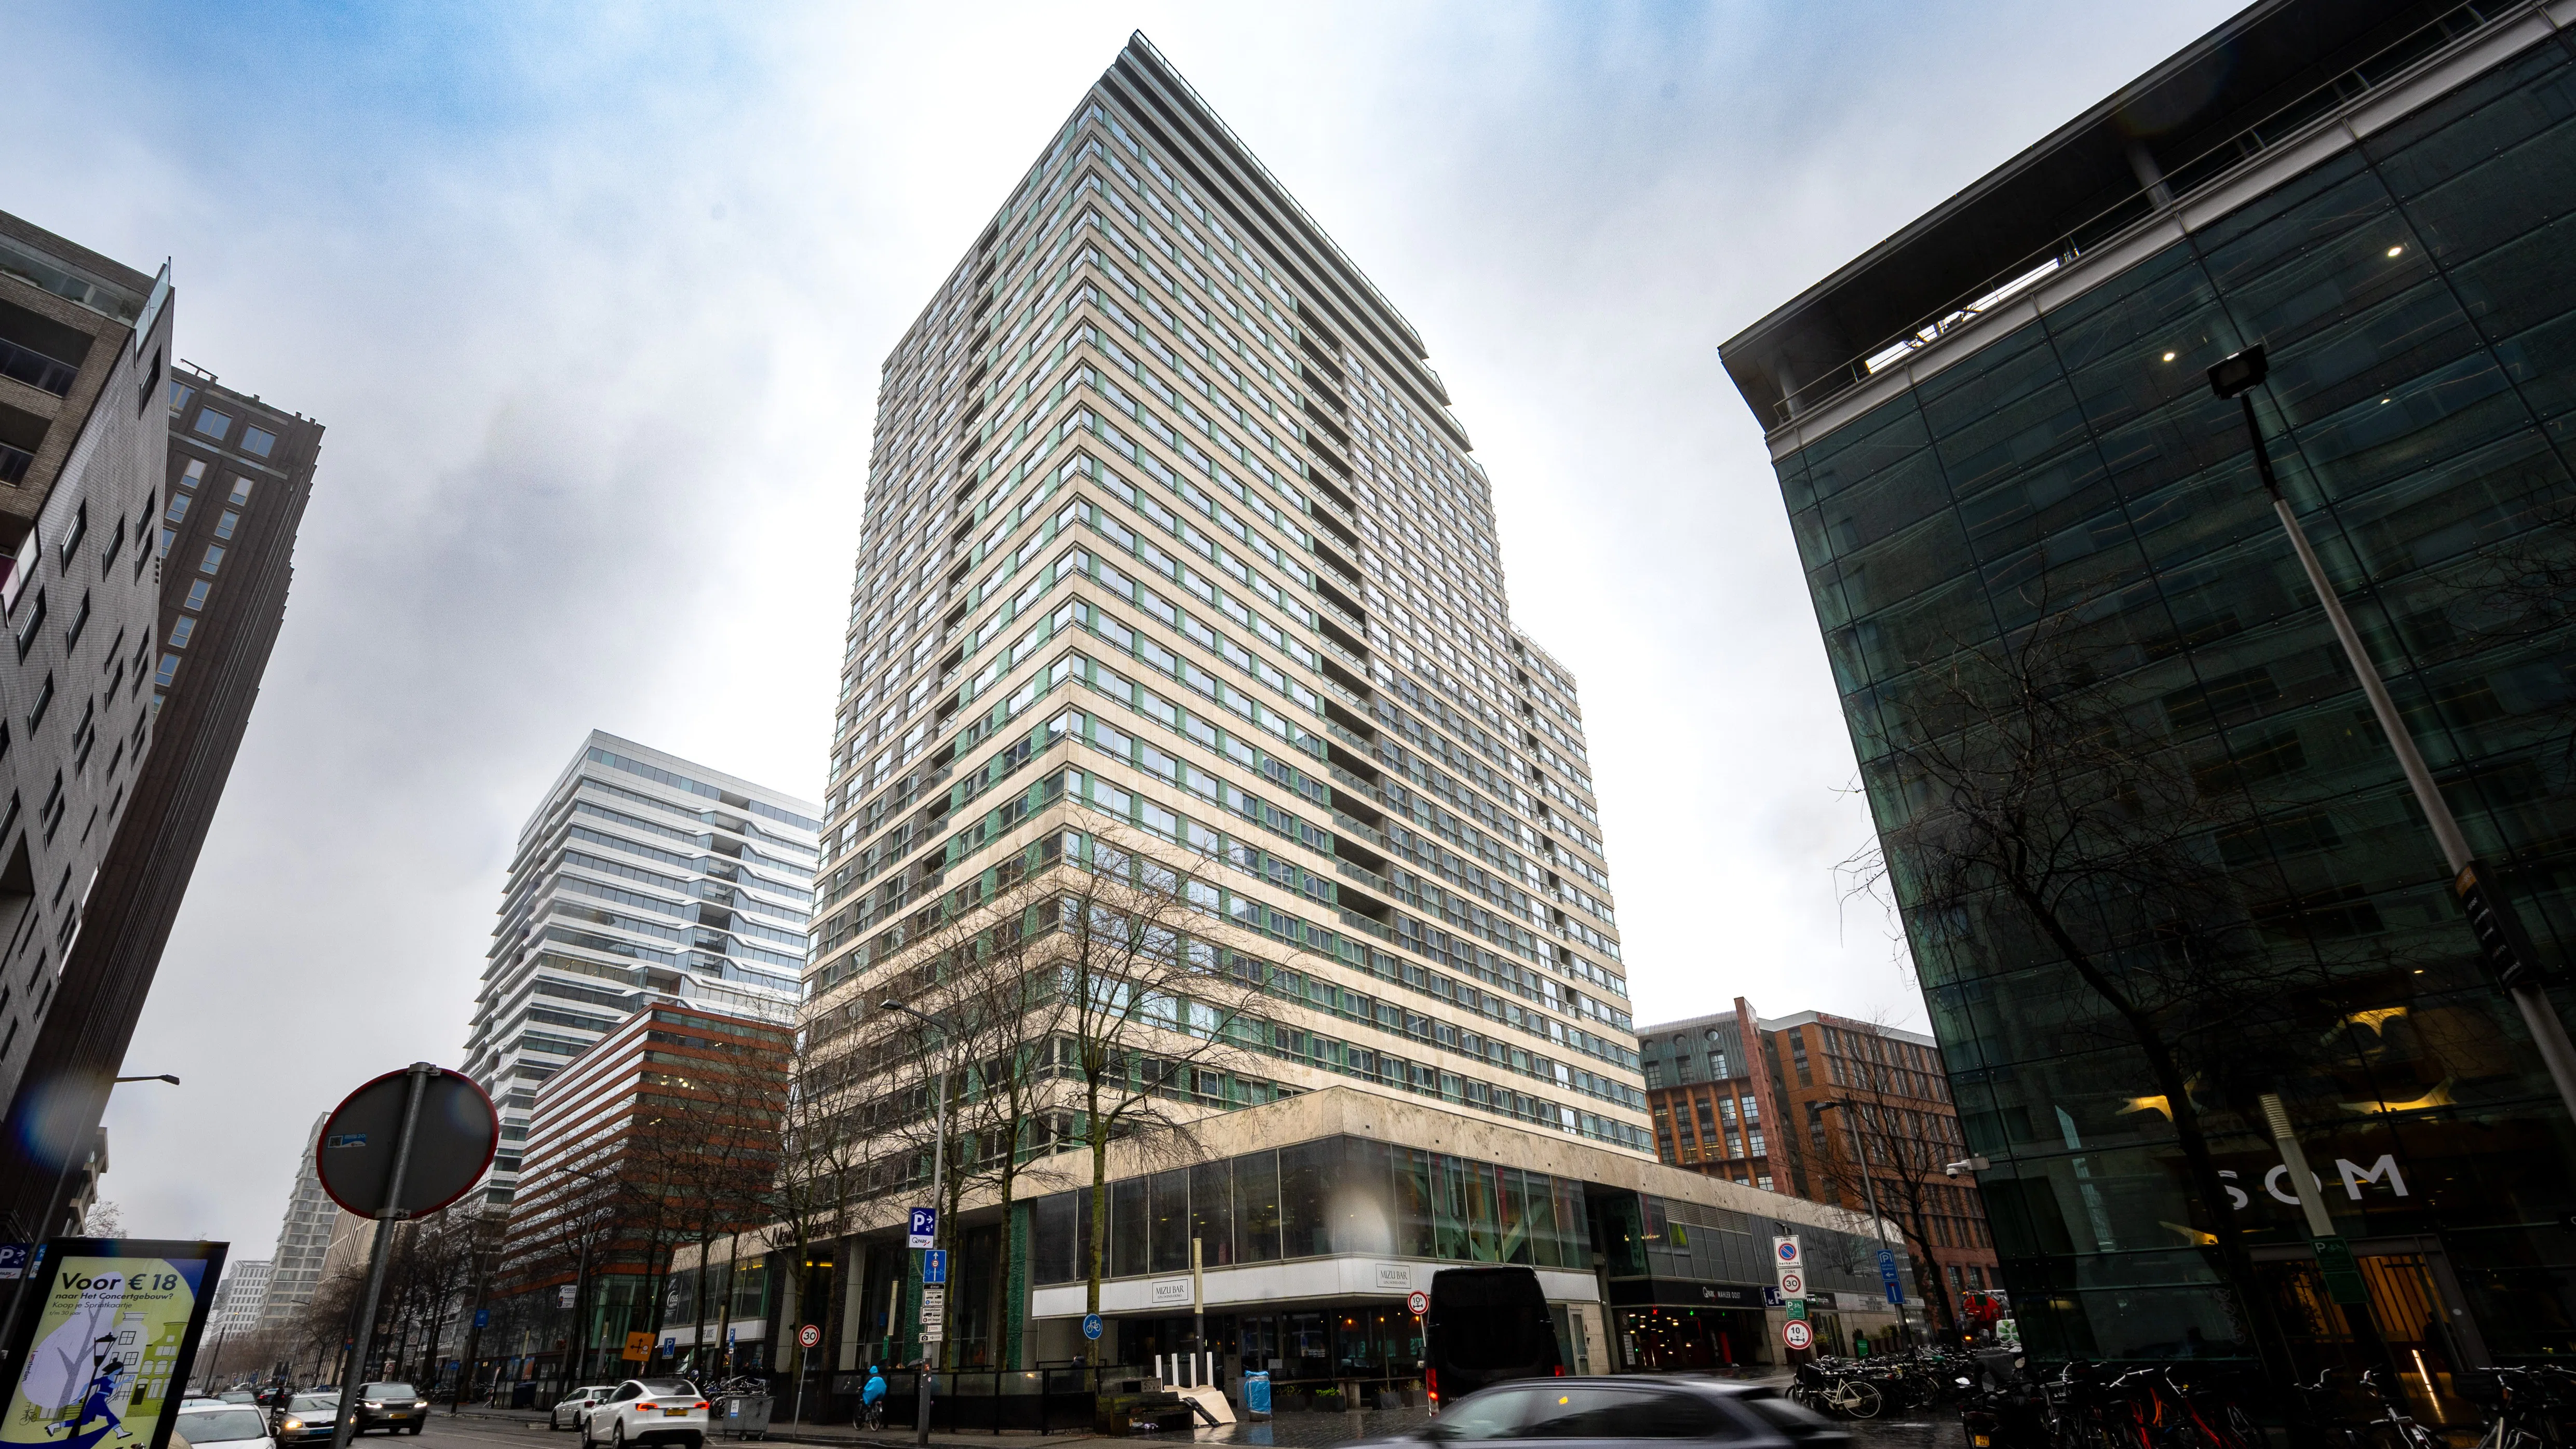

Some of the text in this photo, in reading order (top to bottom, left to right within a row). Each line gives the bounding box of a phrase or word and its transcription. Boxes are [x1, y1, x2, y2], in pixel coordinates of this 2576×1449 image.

[913, 1214, 925, 1231] P
[2314, 1242, 2326, 1253] P
[1381, 1270, 1408, 1280] MIZU BAR
[62, 1272, 178, 1291] Voor € 18
[1156, 1285, 1184, 1294] MIZU BAR
[99, 1293, 173, 1301] Concertgebouw?
[803, 1332, 816, 1340] 30
[667, 1339, 673, 1349] P
